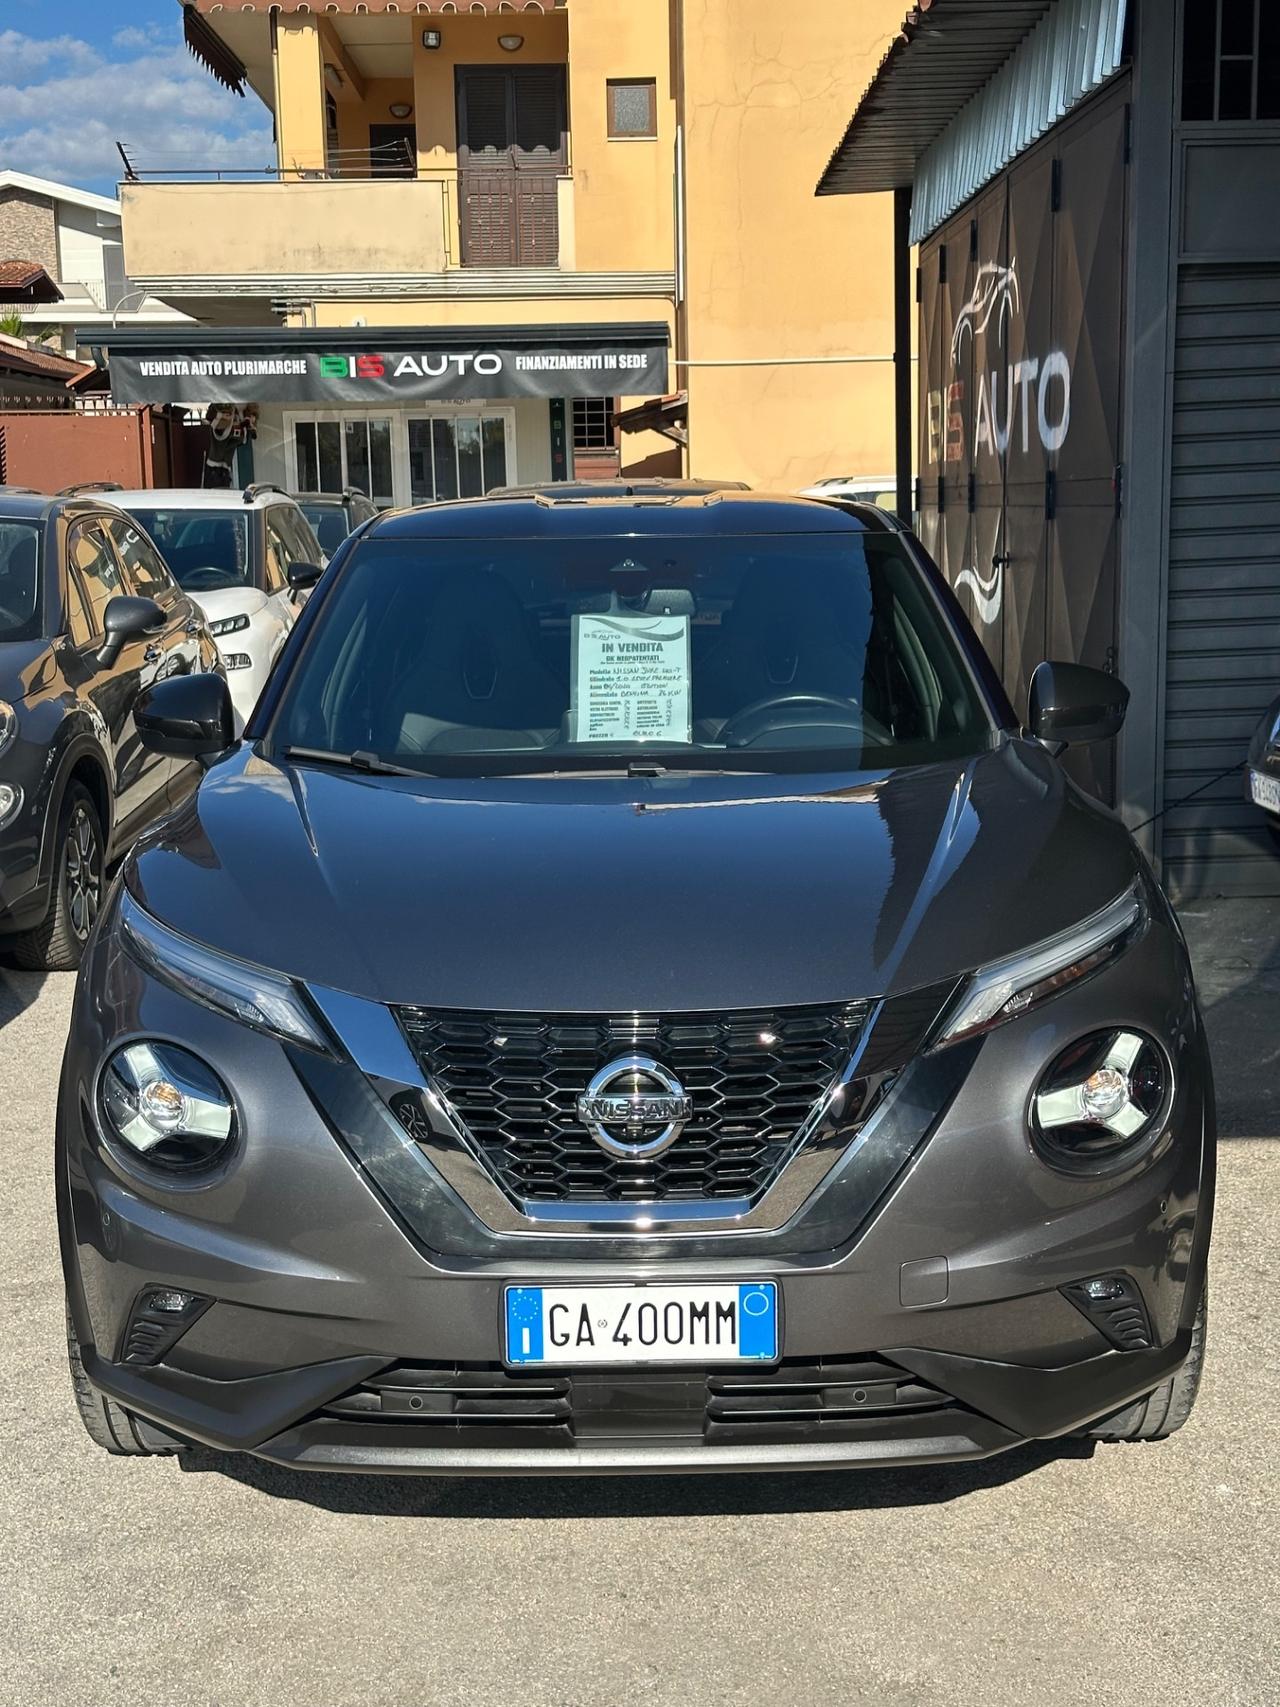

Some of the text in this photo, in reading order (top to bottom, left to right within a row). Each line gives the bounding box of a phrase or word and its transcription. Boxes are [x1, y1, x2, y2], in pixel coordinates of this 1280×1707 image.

[140, 360, 307, 376] VENDITA AUTO PLURIMARCHE
[320, 354, 502, 378] BIS AUTO
[516, 354, 648, 370] FINANZIAMENTI IN SEDE
[974, 351, 1070, 458] AUTO
[602, 642, 663, 652] IN VENDITA
[590, 1099, 681, 1119] NISSAN
